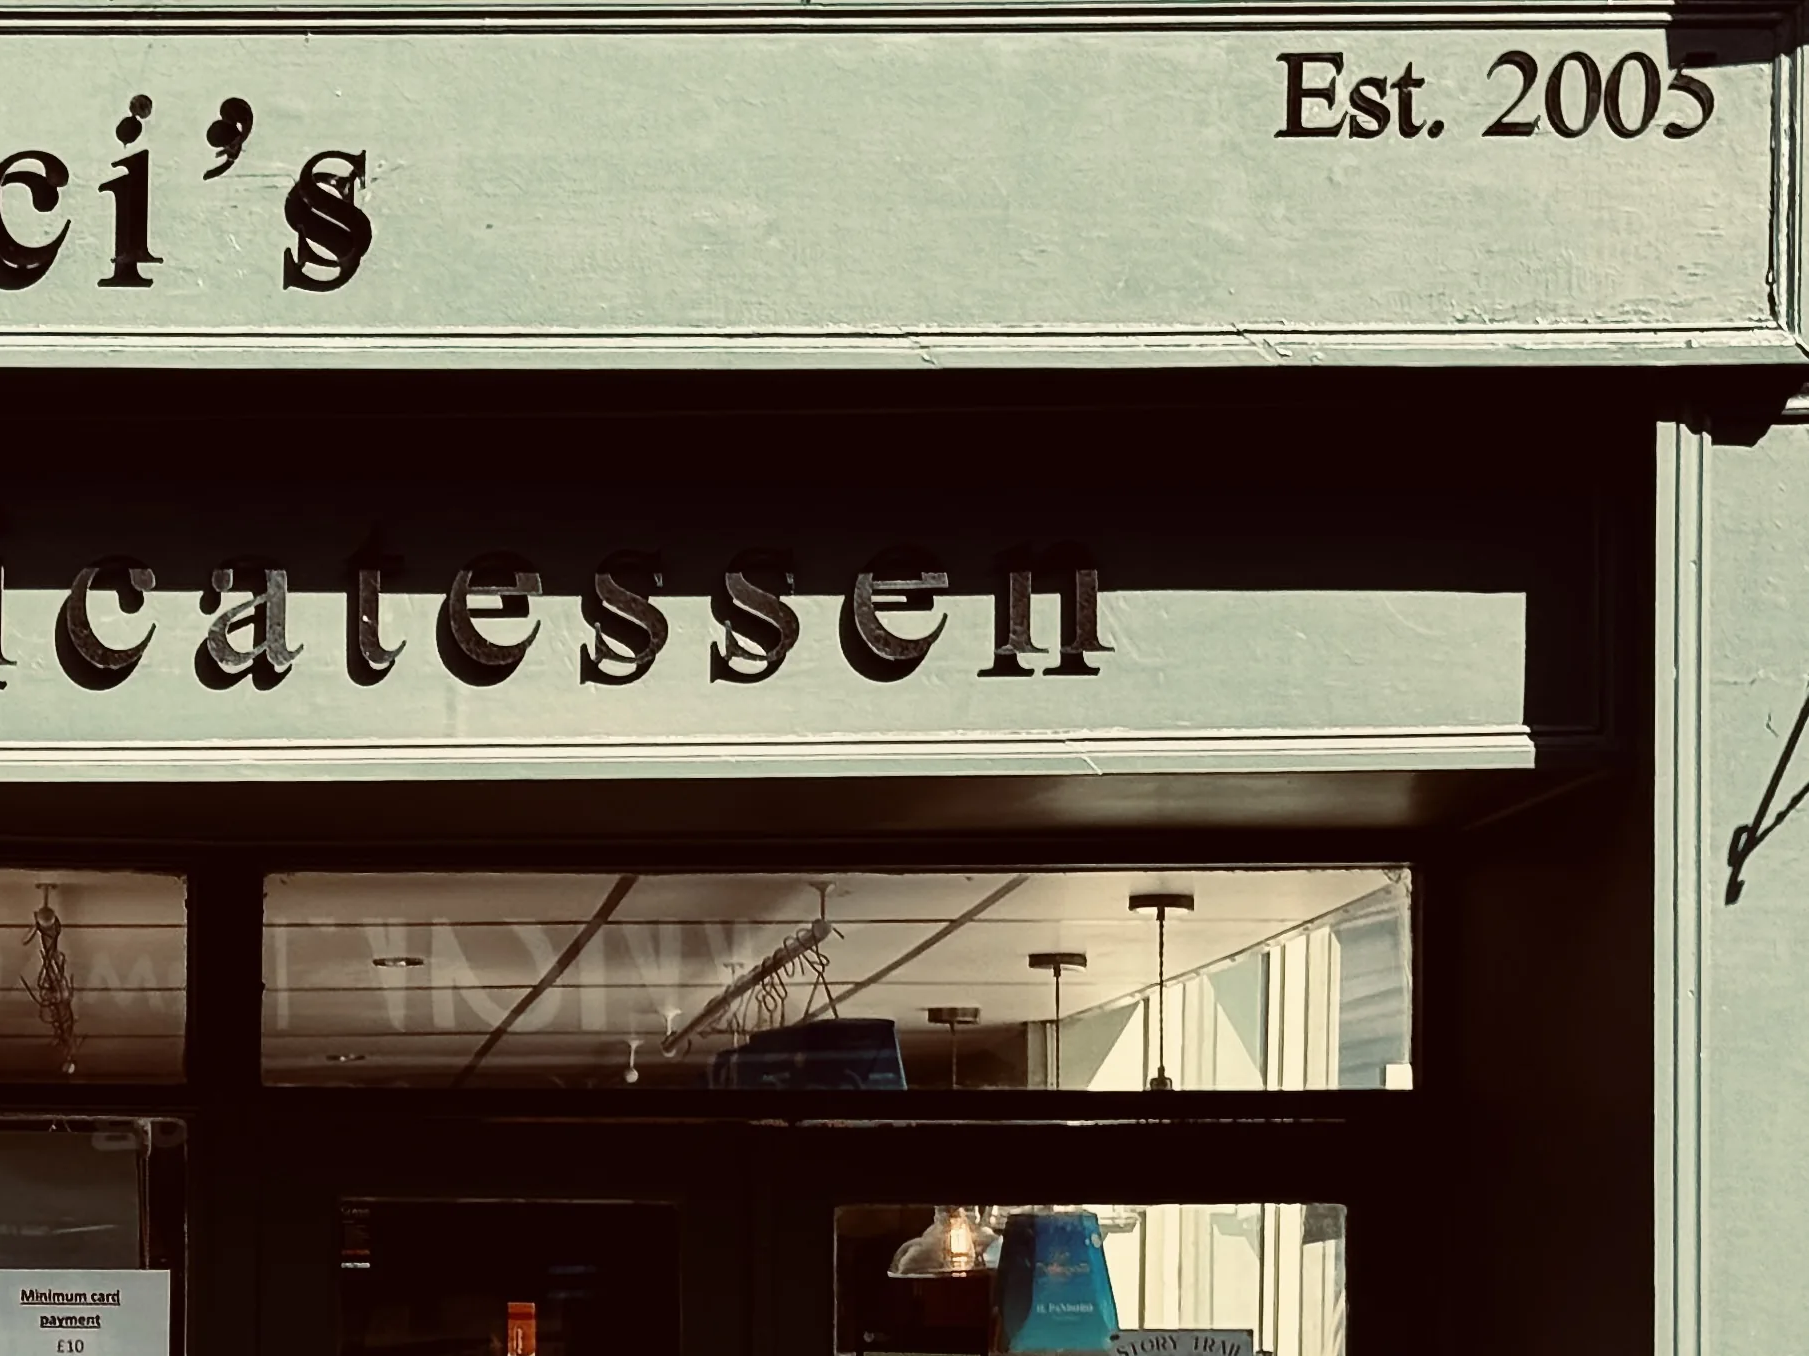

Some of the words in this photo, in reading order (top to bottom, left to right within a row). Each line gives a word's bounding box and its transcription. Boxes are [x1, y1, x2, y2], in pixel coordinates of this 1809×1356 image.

[1274, 51, 1445, 139] Est.
[1482, 50, 1716, 139] 2005
[19, 1288, 87, 1306] Minimum
[90, 1288, 121, 1306] card
[39, 1314, 101, 1329] payment
[56, 1339, 85, 1354] £10
